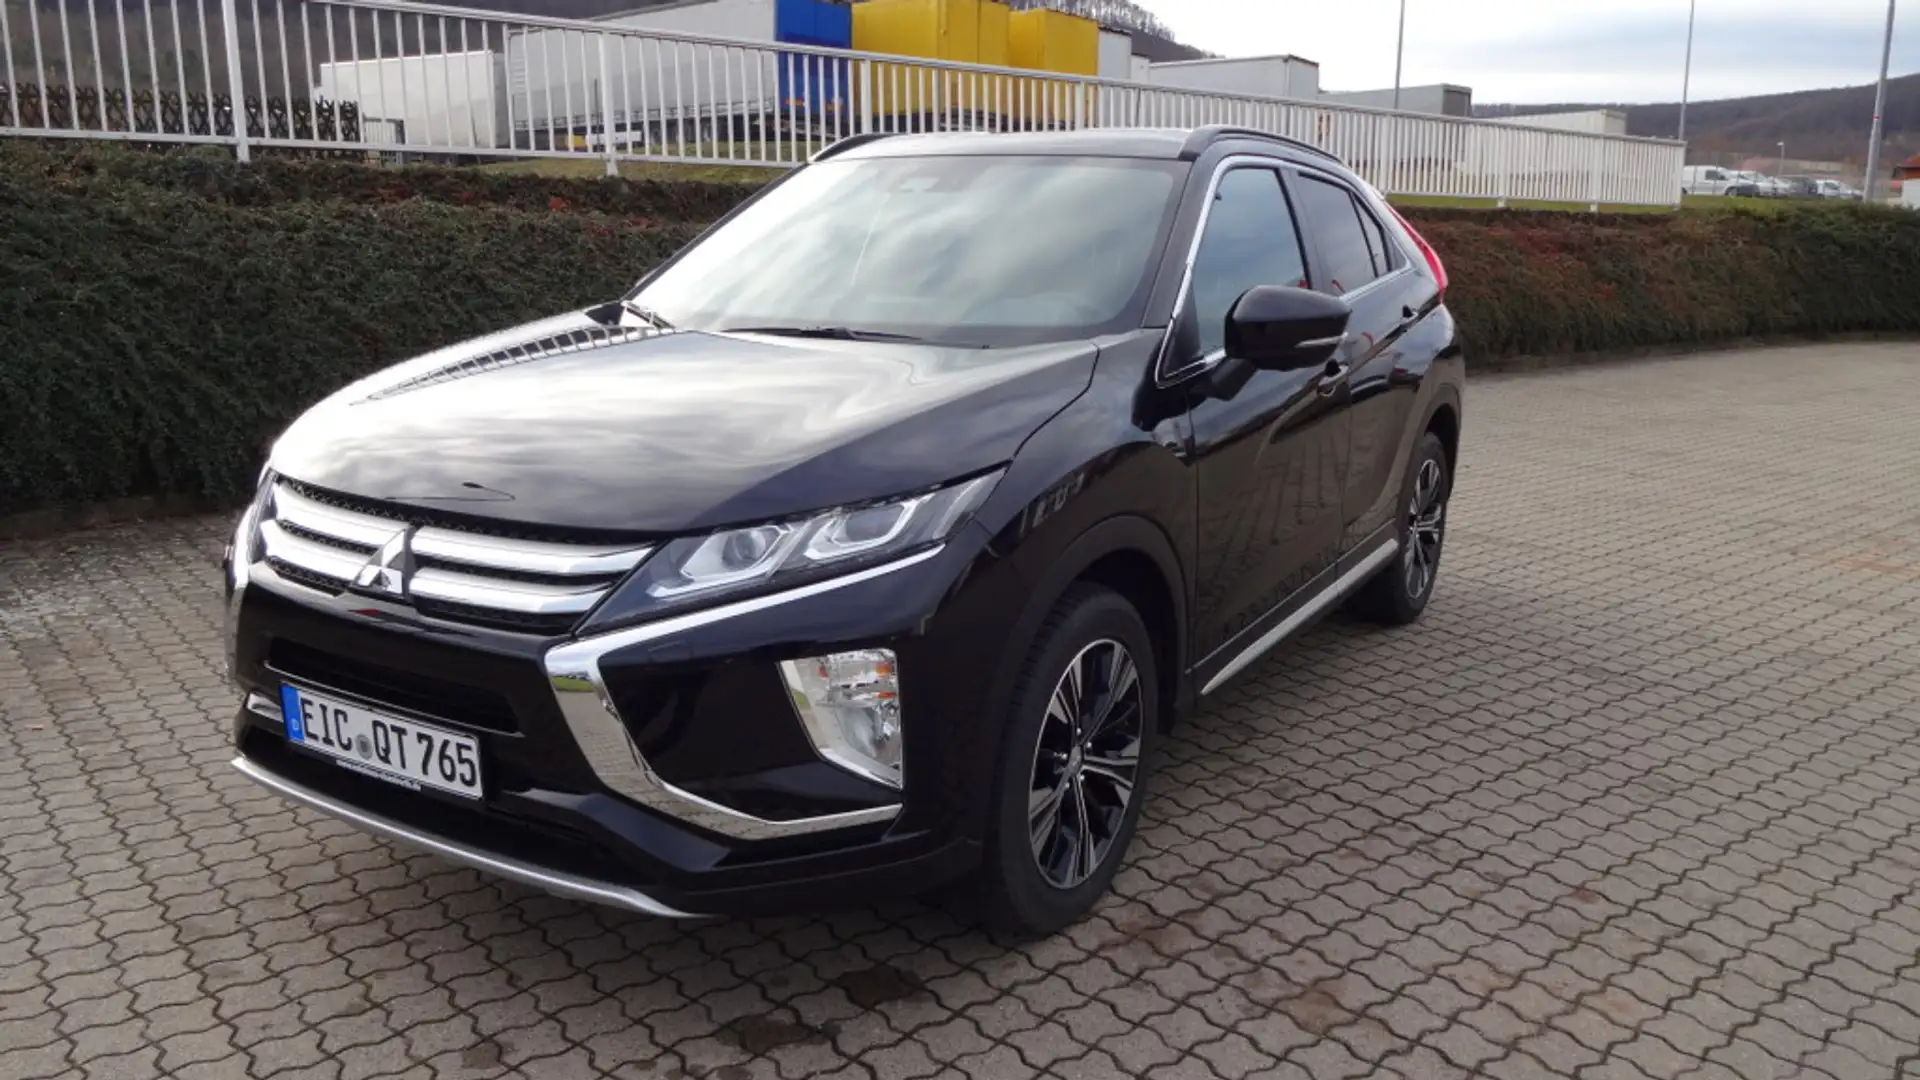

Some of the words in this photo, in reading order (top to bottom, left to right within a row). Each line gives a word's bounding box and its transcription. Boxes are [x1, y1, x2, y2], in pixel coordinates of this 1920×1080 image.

[301, 697, 352, 751] EIC
[372, 720, 408, 769] QT
[417, 732, 477, 787] 765
